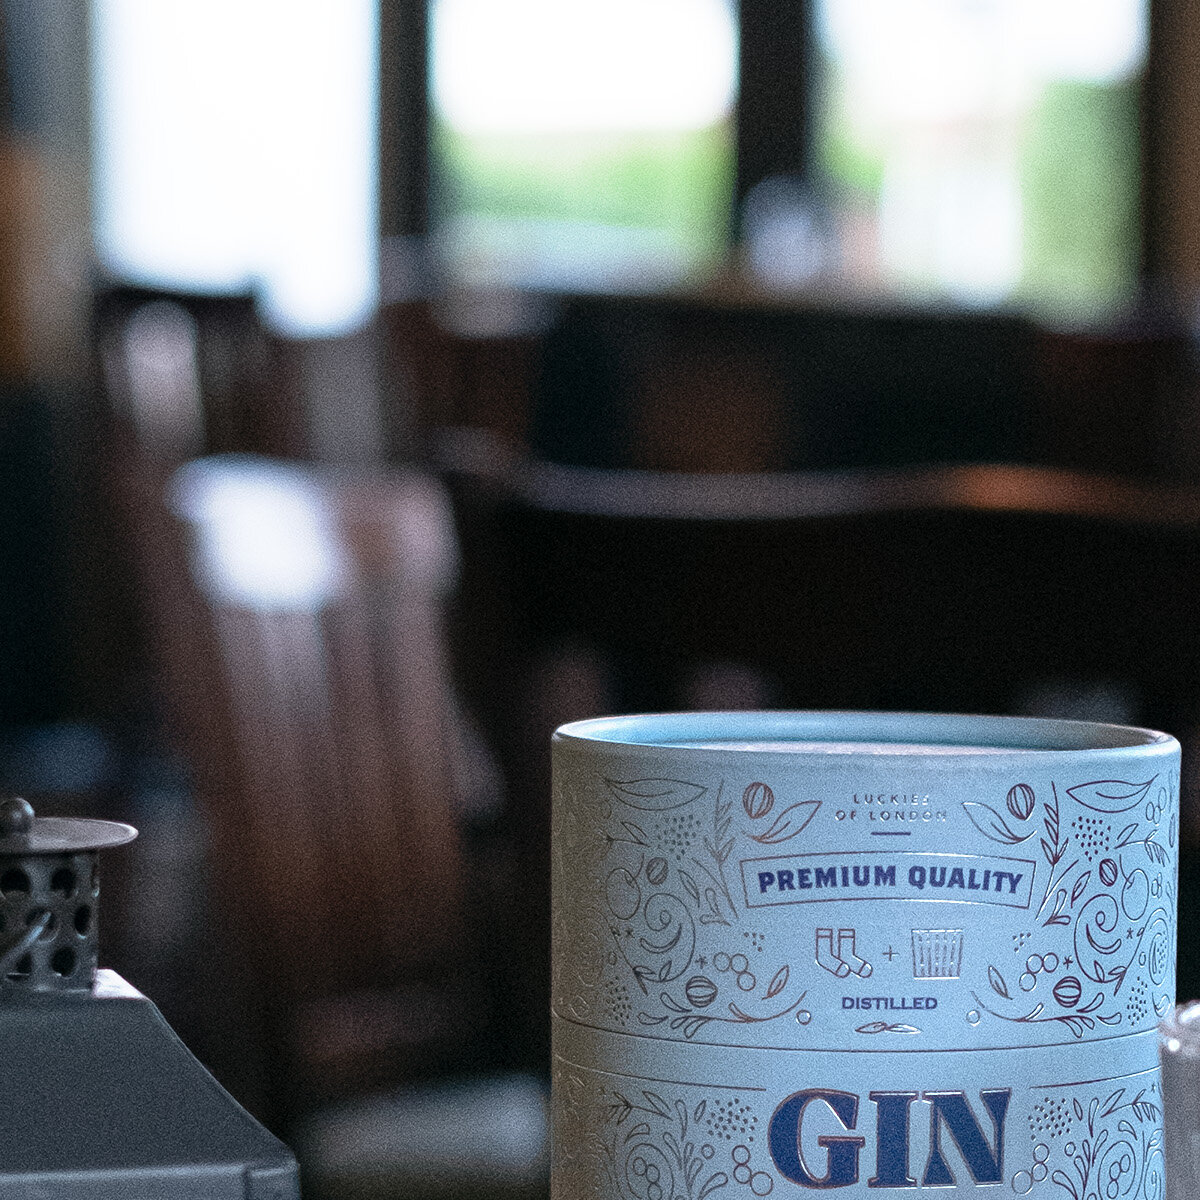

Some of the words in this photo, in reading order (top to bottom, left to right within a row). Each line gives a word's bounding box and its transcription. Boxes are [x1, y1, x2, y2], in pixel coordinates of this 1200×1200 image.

[834, 810, 857, 822] OF
[868, 810, 948, 823] LONDON
[758, 865, 897, 894] PREMIUM
[908, 865, 1023, 894] QUALITY
[841, 996, 938, 1010] DISTILLED
[767, 1087, 1013, 1190] GIN
